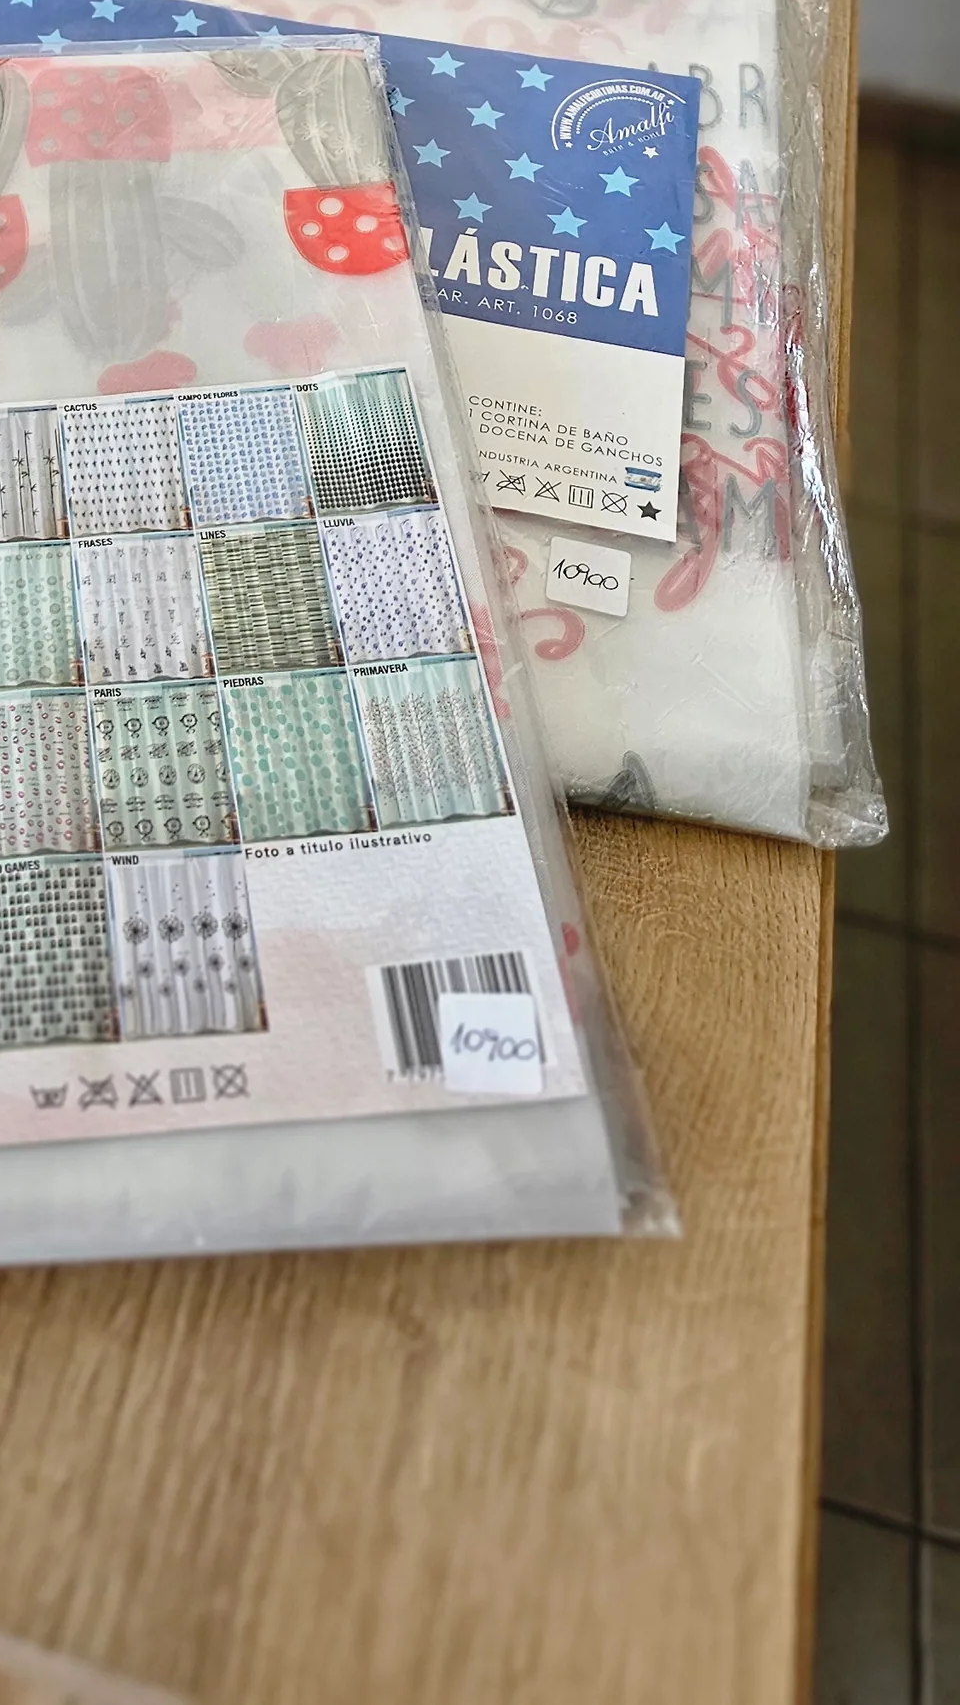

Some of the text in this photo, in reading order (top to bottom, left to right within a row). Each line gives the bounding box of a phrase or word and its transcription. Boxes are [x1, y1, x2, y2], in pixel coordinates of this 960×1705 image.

[559, 84, 666, 141] WWW.AMALFICORTINAS.COM.AR
[586, 101, 676, 151] Amalfi
[420, 226, 660, 317] LÁSTICA
[477, 296, 521, 315] ART.
[532, 305, 578, 325] 1068
[296, 382, 319, 393] DOTS
[178, 393, 202, 402] CAMPO
[213, 390, 239, 399] FLORES
[63, 402, 98, 413] CACTUS
[467, 394, 543, 418] CONTINE:
[480, 410, 551, 433] CORTINA
[556, 423, 578, 437] DE
[583, 428, 629, 447] BAÑO
[479, 423, 664, 468] DOCENA DE GANCHOS
[477, 449, 619, 485] NDUSTRIA ARGENTINA
[322, 516, 356, 528] LLUVIA
[200, 528, 226, 541] LINES
[77, 537, 113, 549] FRASES
[352, 662, 409, 678] PRIMAVERA
[222, 675, 264, 688] PIEDRAS
[93, 687, 122, 698] PARIS
[244, 844, 280, 861] Foto
[286, 846, 295, 857] a
[349, 830, 433, 851] ilustrativo
[4, 860, 41, 873] GAMES
[111, 854, 140, 867] WIND
